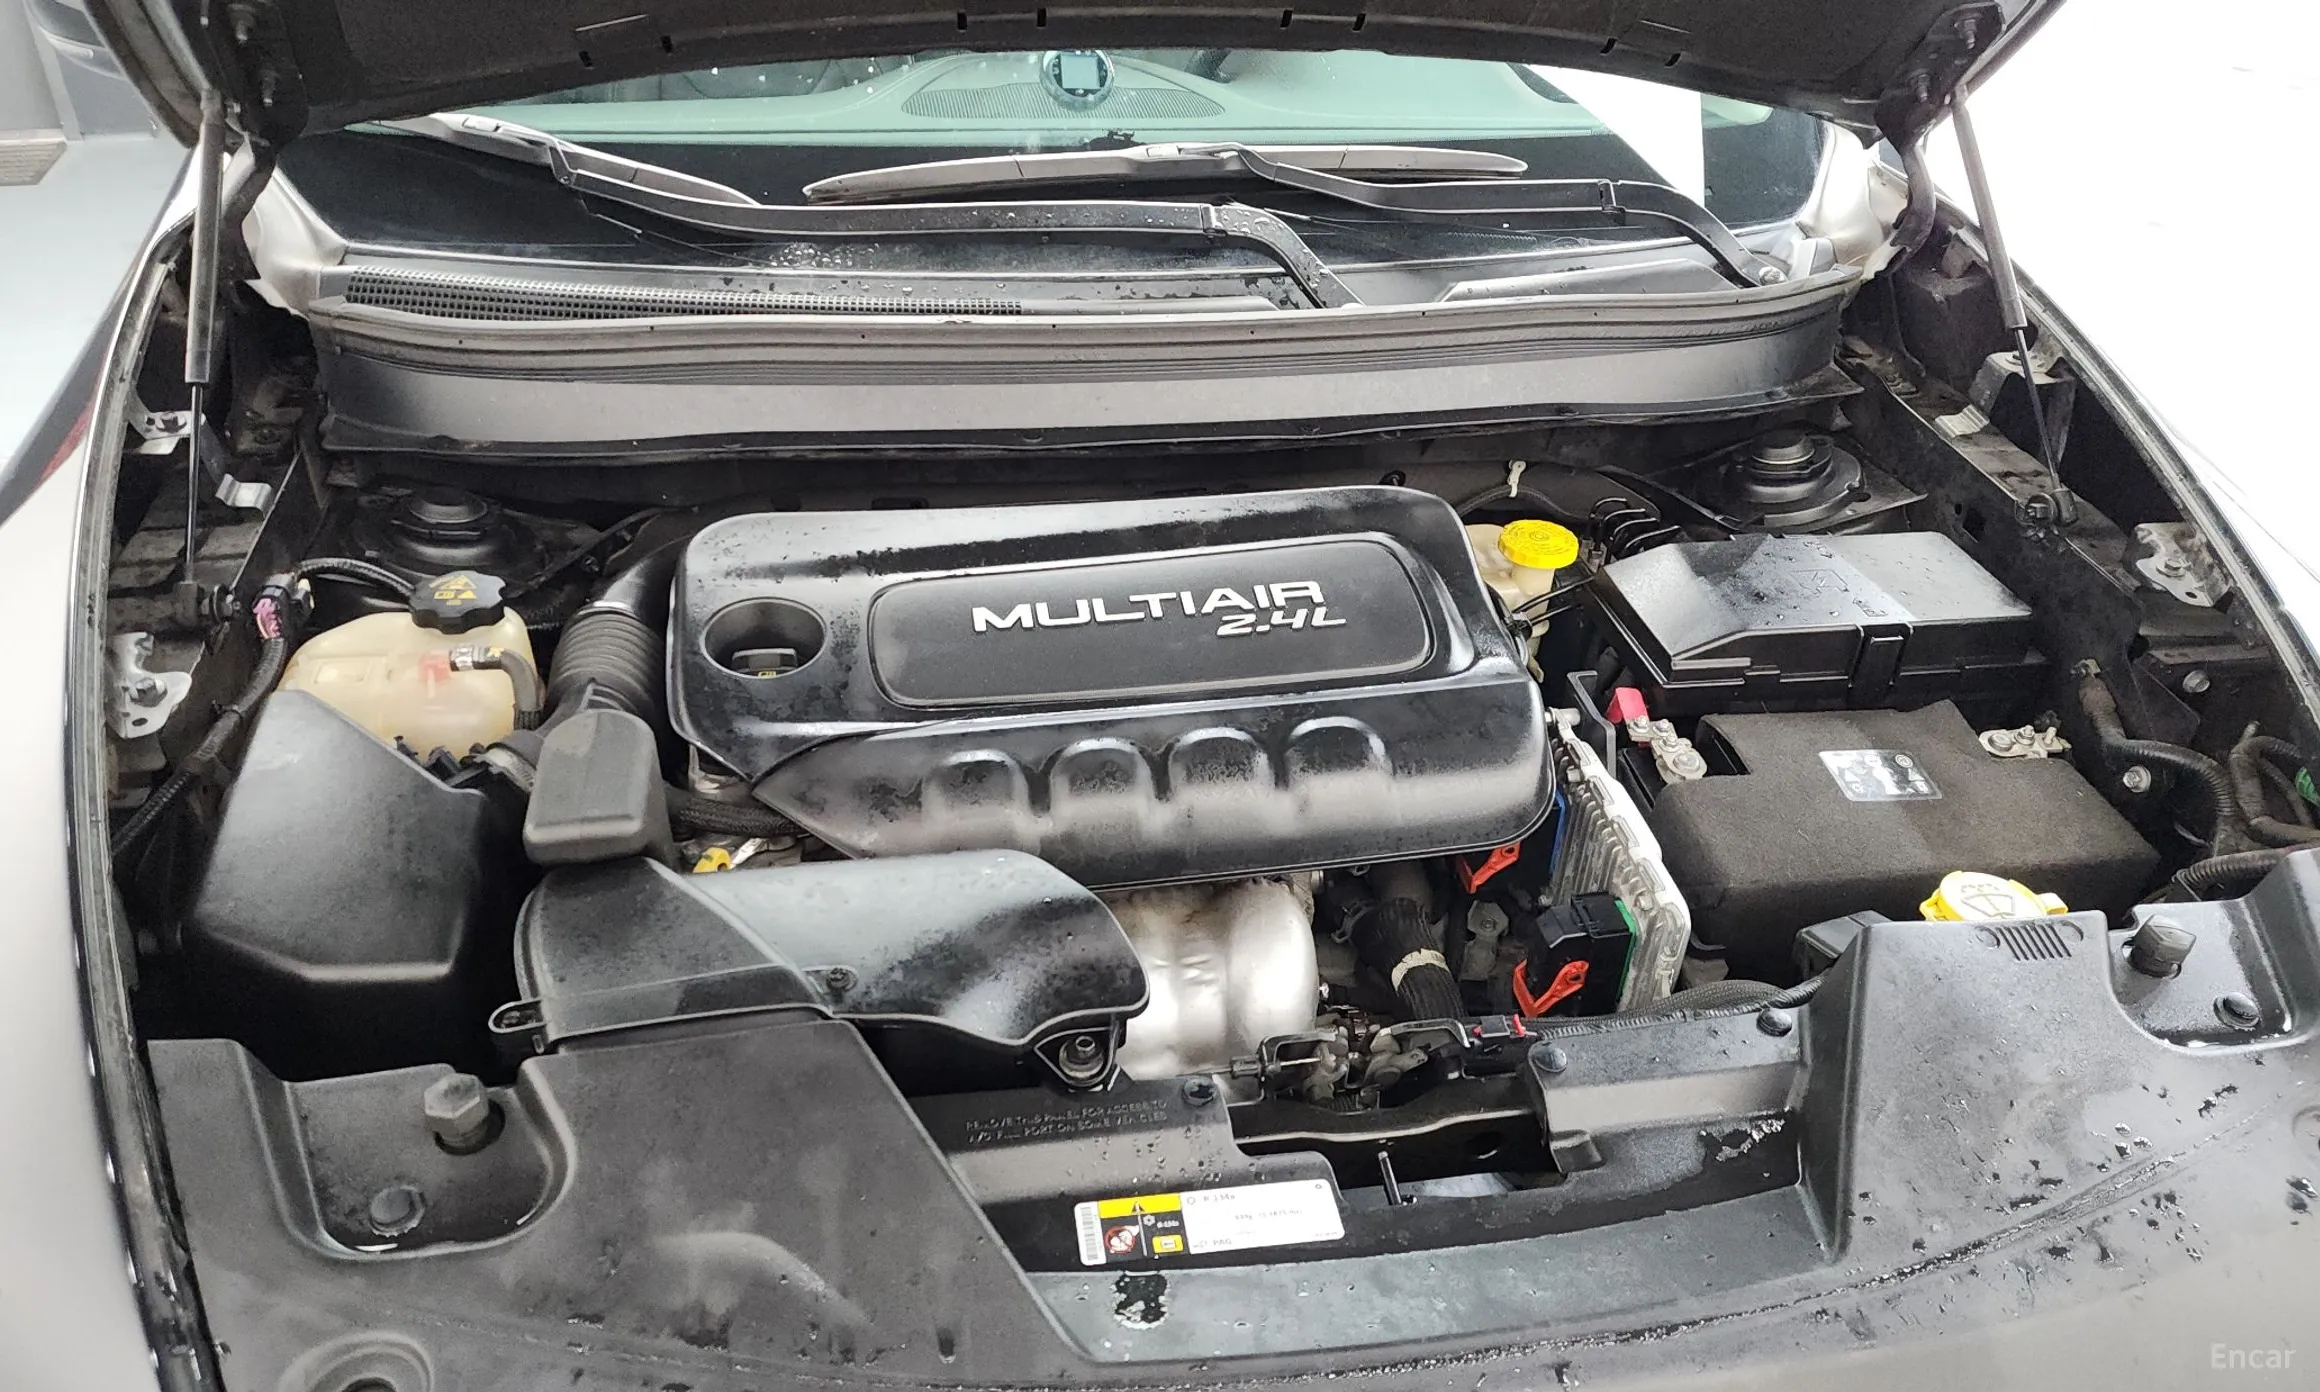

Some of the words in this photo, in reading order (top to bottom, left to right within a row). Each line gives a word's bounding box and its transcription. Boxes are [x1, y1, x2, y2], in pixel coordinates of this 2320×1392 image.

[971, 580, 1326, 633] MULTIAIR
[1215, 607, 1348, 637] 2.4L
[1082, 1106, 1104, 1119] FOR
